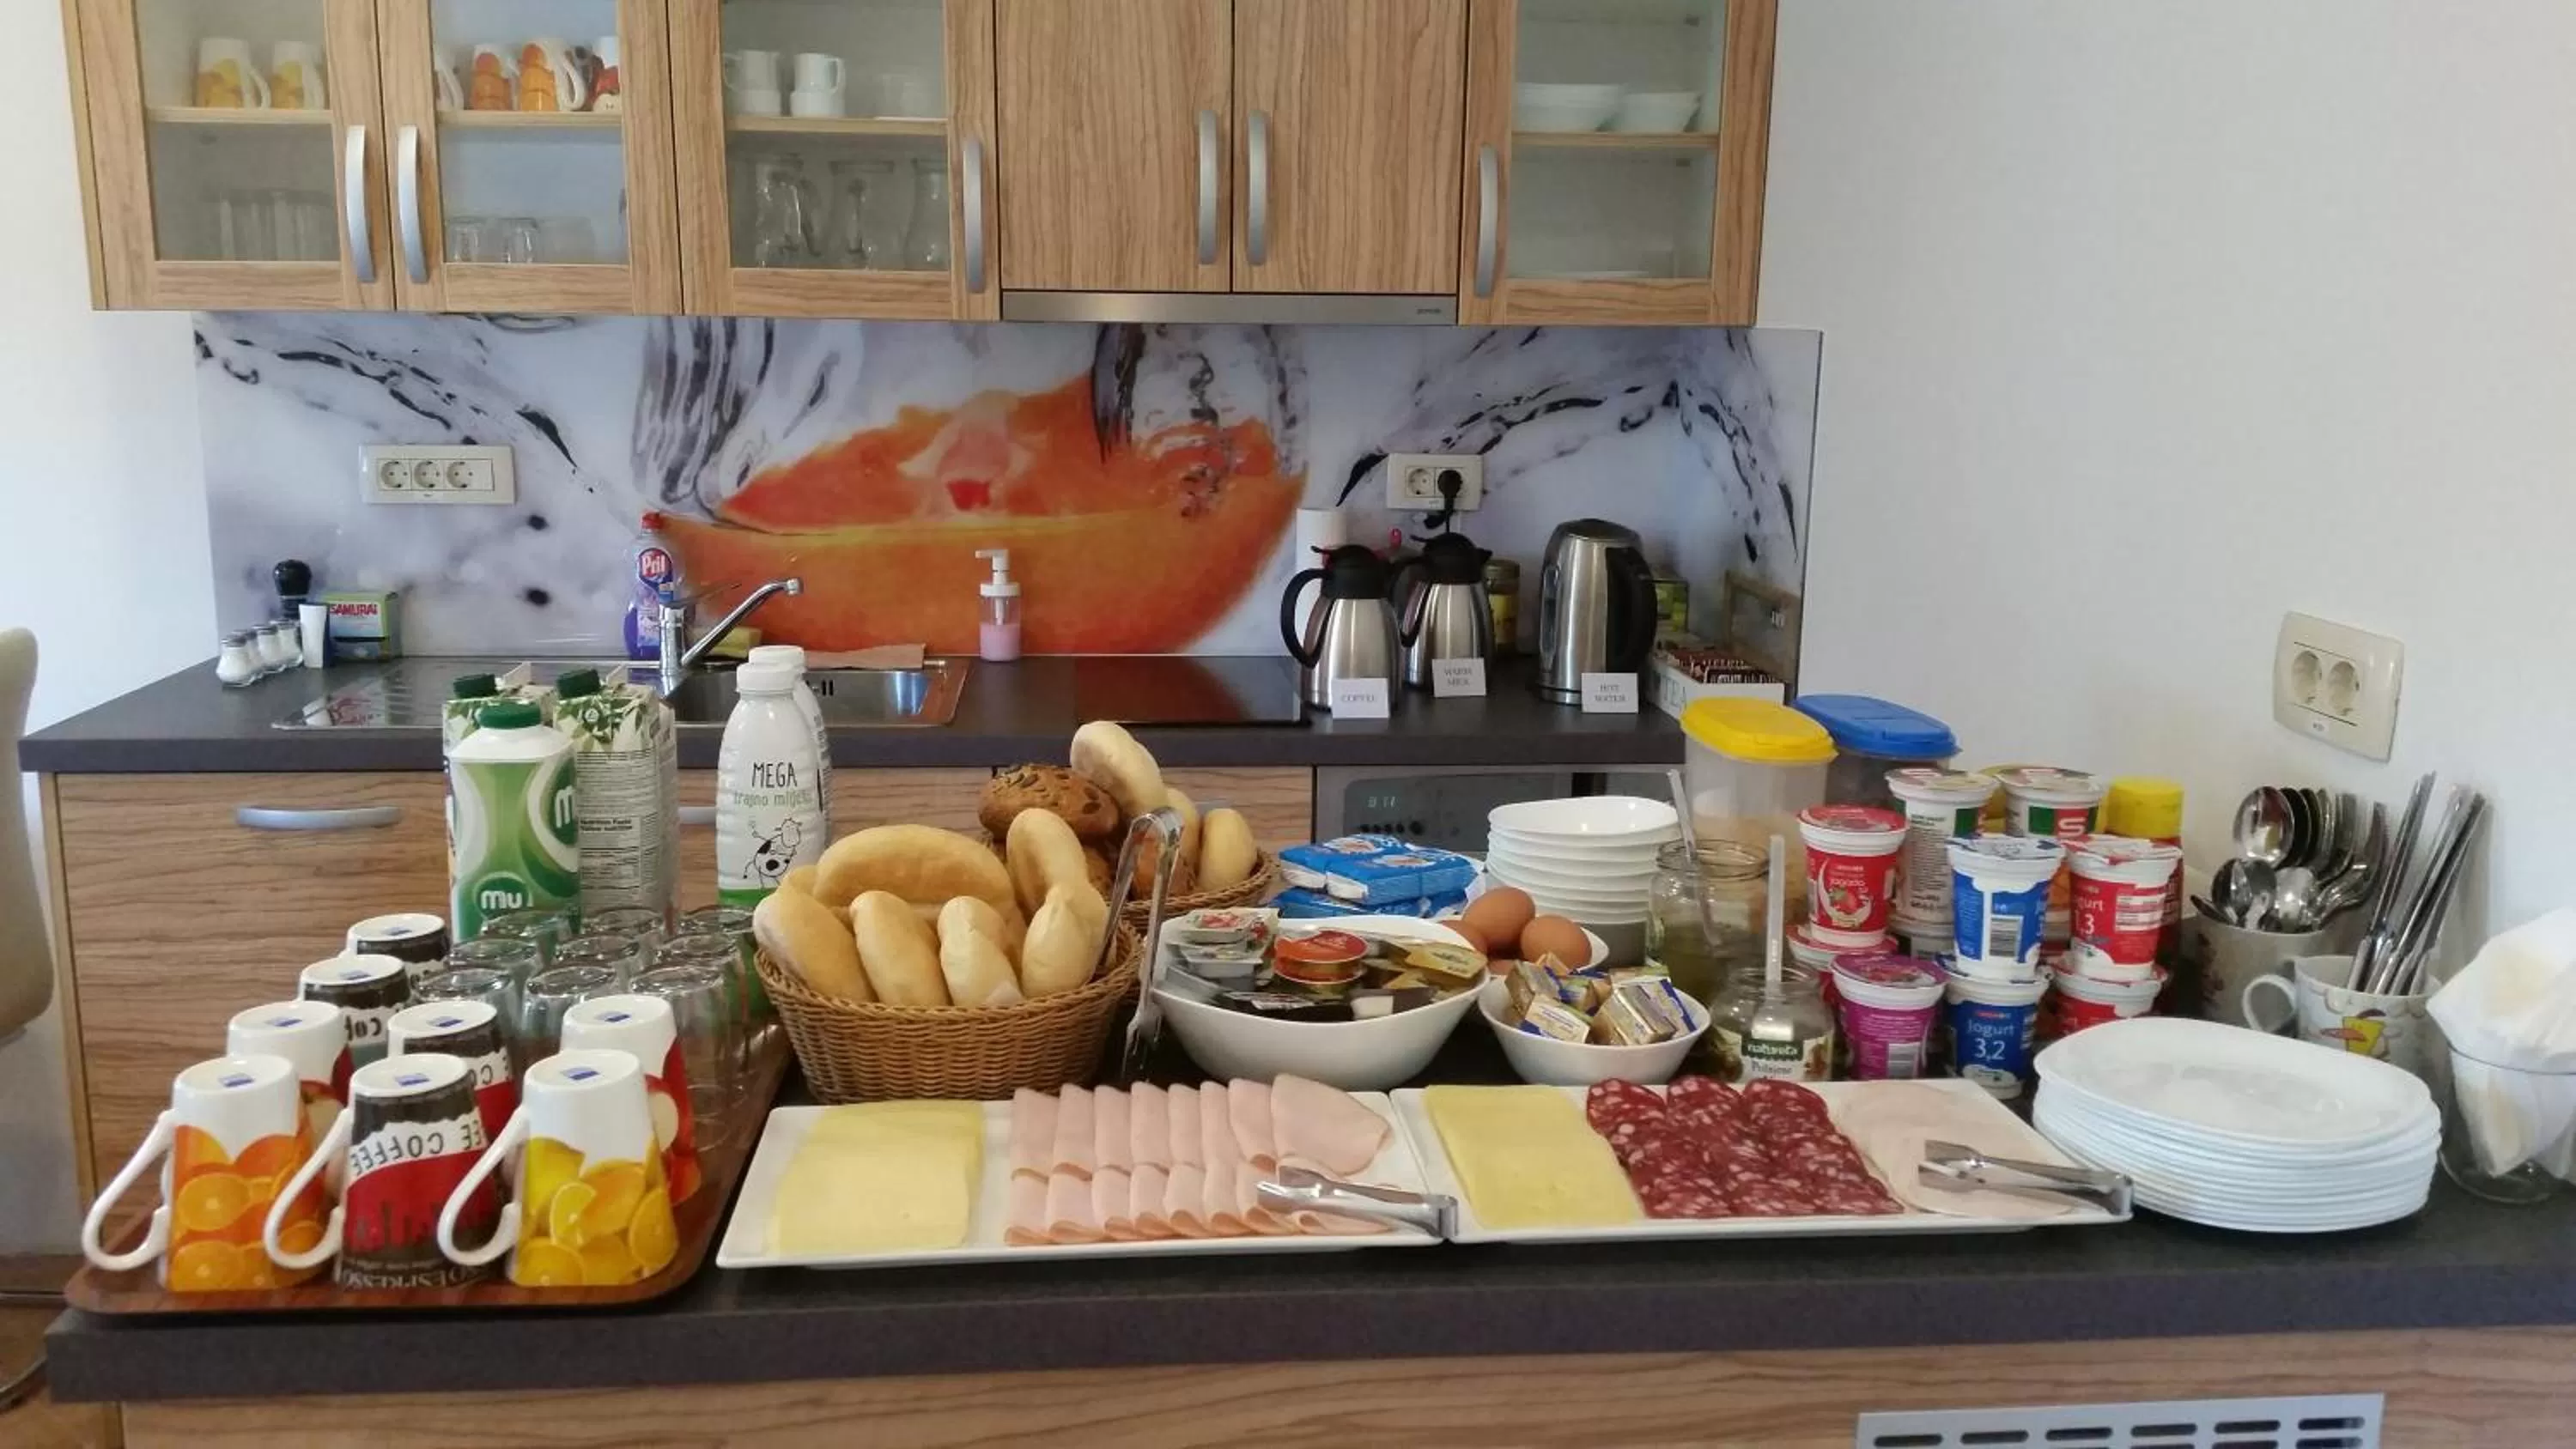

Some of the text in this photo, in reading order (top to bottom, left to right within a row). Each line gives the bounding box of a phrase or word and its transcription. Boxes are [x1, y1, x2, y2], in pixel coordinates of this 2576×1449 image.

[641, 552, 666, 574] Pril
[329, 603, 378, 615] SAMURAI
[751, 761, 798, 788] MEGA
[480, 890, 523, 910] mu
[1747, 1043, 1798, 1056] natureta
[1974, 1037, 2006, 1062] 3,2
